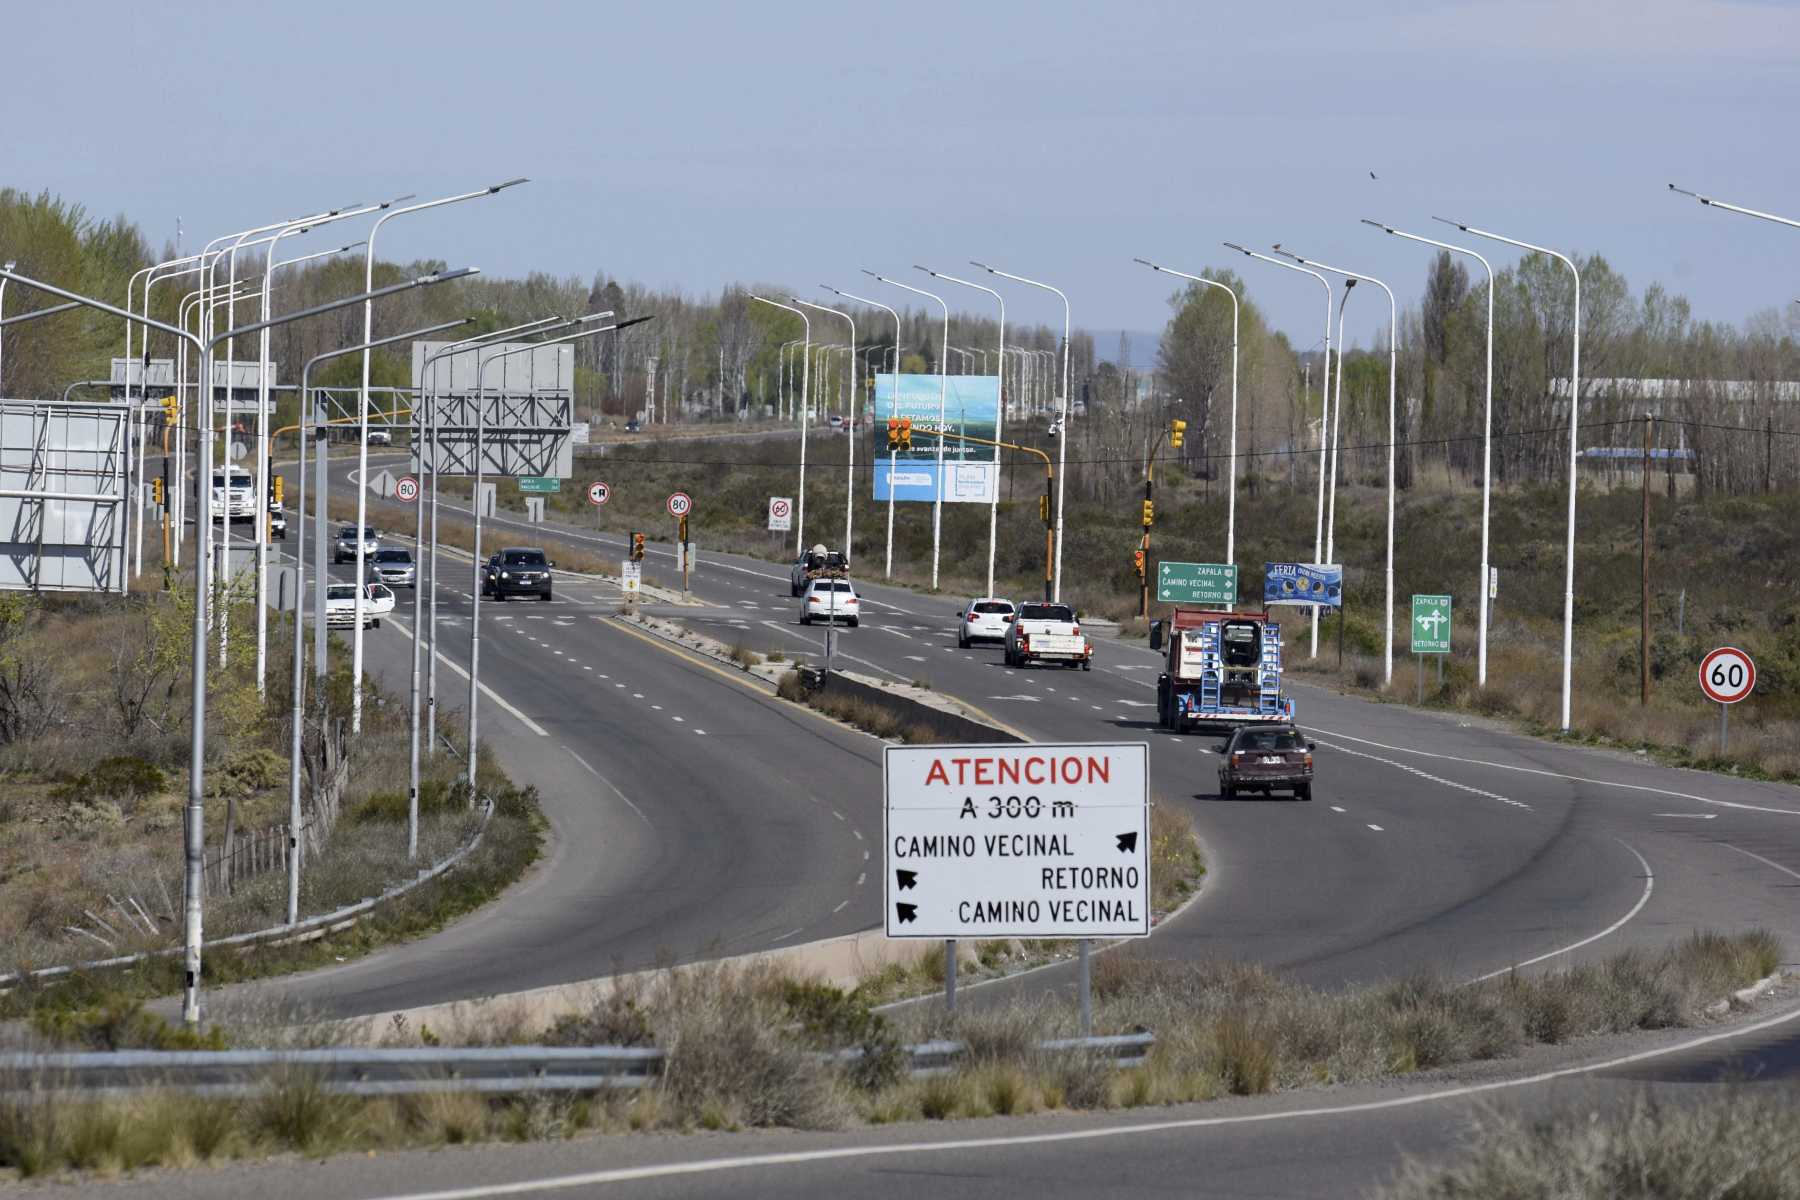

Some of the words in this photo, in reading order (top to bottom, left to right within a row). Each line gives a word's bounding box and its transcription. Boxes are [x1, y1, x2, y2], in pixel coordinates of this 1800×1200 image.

[401, 484, 414, 495] 80
[672, 500, 686, 510] 80
[1162, 577, 1187, 587] CAMINO
[1190, 579, 1216, 588] VECINAL
[1198, 567, 1222, 576] ZAPALA
[1192, 590, 1222, 599] RETORNO
[1711, 663, 1743, 688] 60
[925, 756, 1110, 786] ATENCION
[960, 796, 977, 819] A
[988, 796, 1041, 819] 300
[1052, 801, 1075, 818] m
[894, 835, 976, 858] CAMINO
[984, 834, 1074, 857] VECINAL
[1042, 866, 1139, 889] RETORNO
[958, 900, 1040, 924] CAMINO
[1049, 900, 1139, 923] VECINAL
